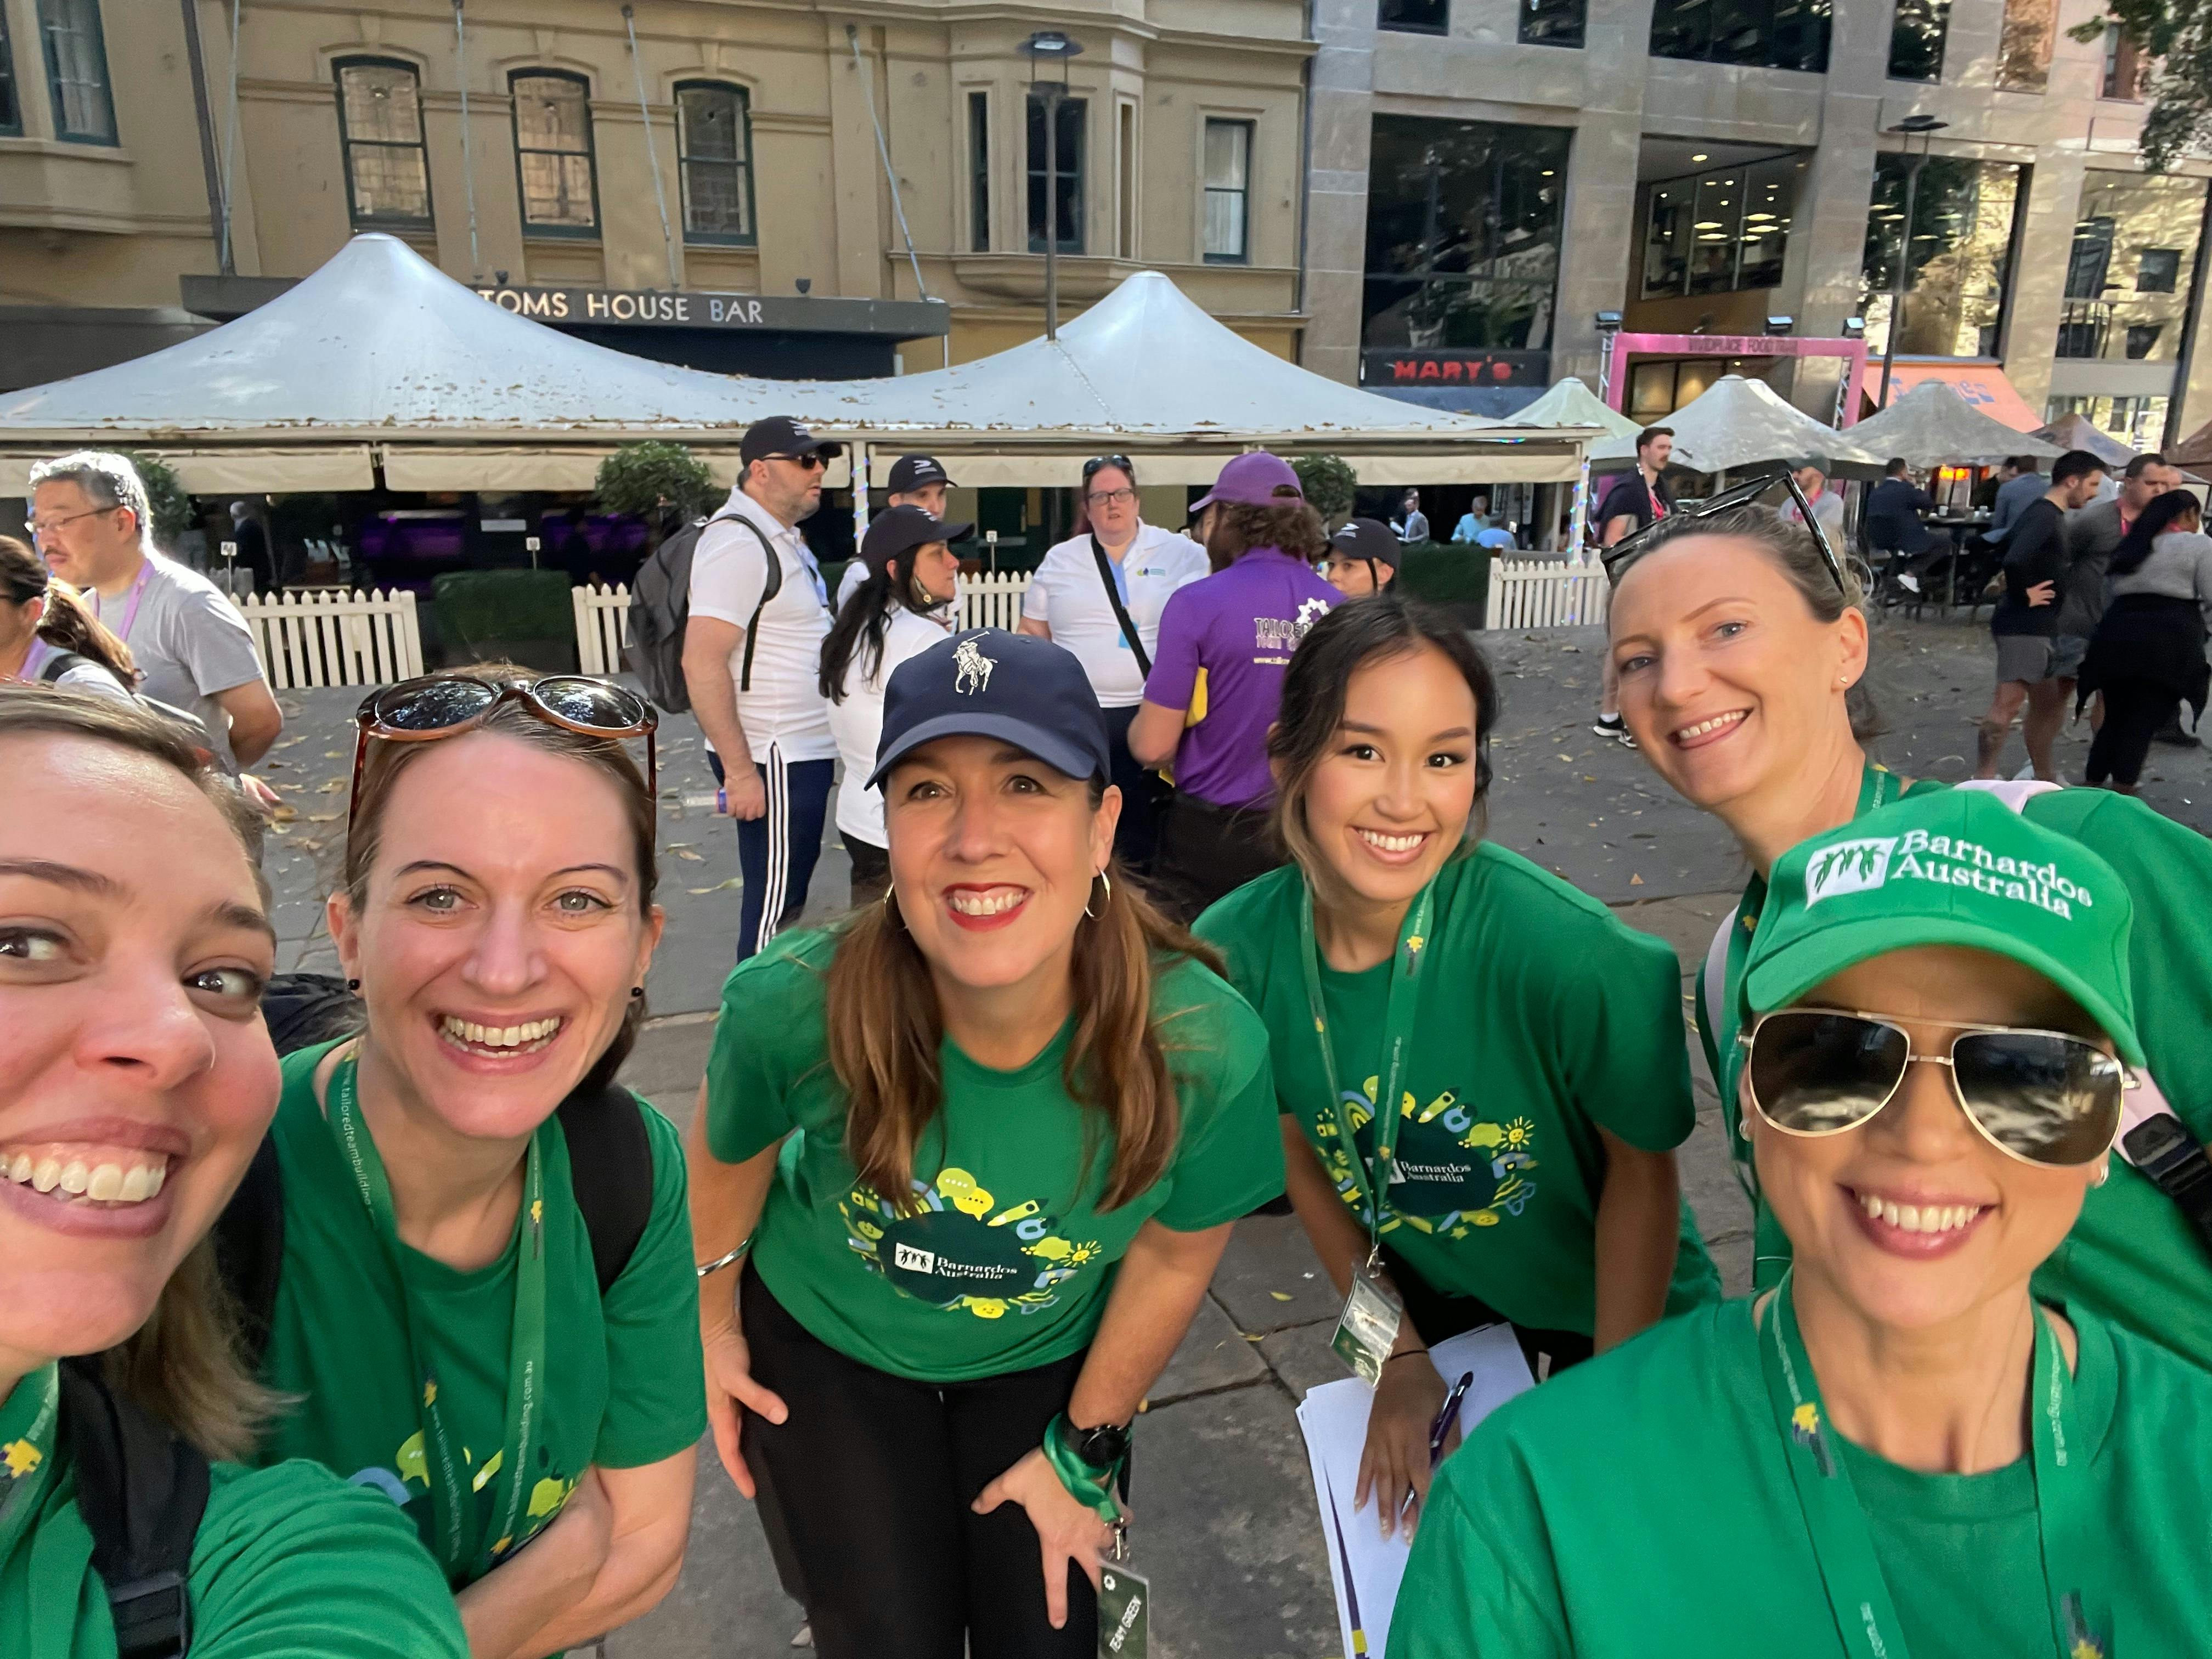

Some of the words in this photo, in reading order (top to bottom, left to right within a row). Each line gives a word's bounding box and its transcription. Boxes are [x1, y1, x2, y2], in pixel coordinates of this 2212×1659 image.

[587, 292, 690, 321] HOUSE
[710, 298, 764, 324] BAR
[1898, 828, 2093, 907] Barnardos
[1891, 852, 2073, 921] Australia
[1400, 1161, 1471, 1173] Barnardos
[935, 1266, 1003, 1279] Australia
[937, 1256, 1018, 1274] Barnardos
